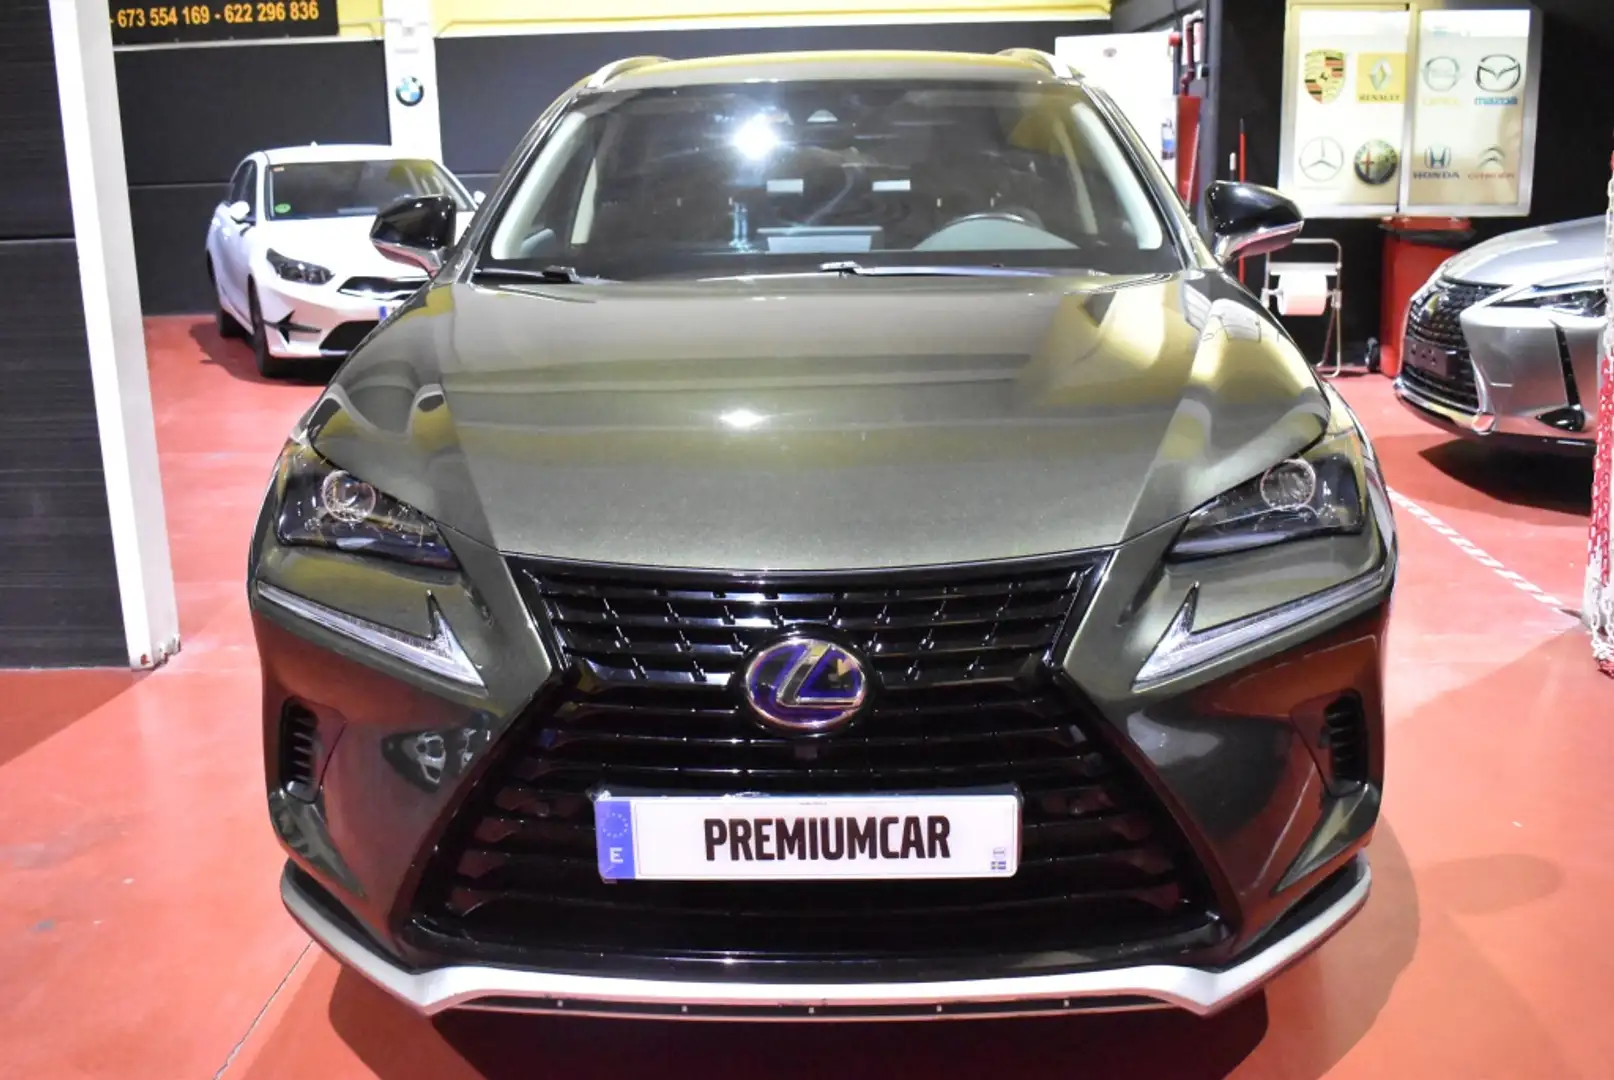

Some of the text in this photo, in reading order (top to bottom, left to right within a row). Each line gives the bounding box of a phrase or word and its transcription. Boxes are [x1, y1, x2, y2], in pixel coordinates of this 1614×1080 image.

[117, 9, 145, 27] 673
[150, 8, 178, 26] 554
[182, 6, 210, 25] 169
[224, 4, 253, 23] 622
[257, 3, 285, 22] 296
[290, 1, 320, 20] 836
[1413, 171, 1460, 179] HONDA
[704, 815, 951, 861] PREMIUMCAR
[609, 847, 624, 864] E
